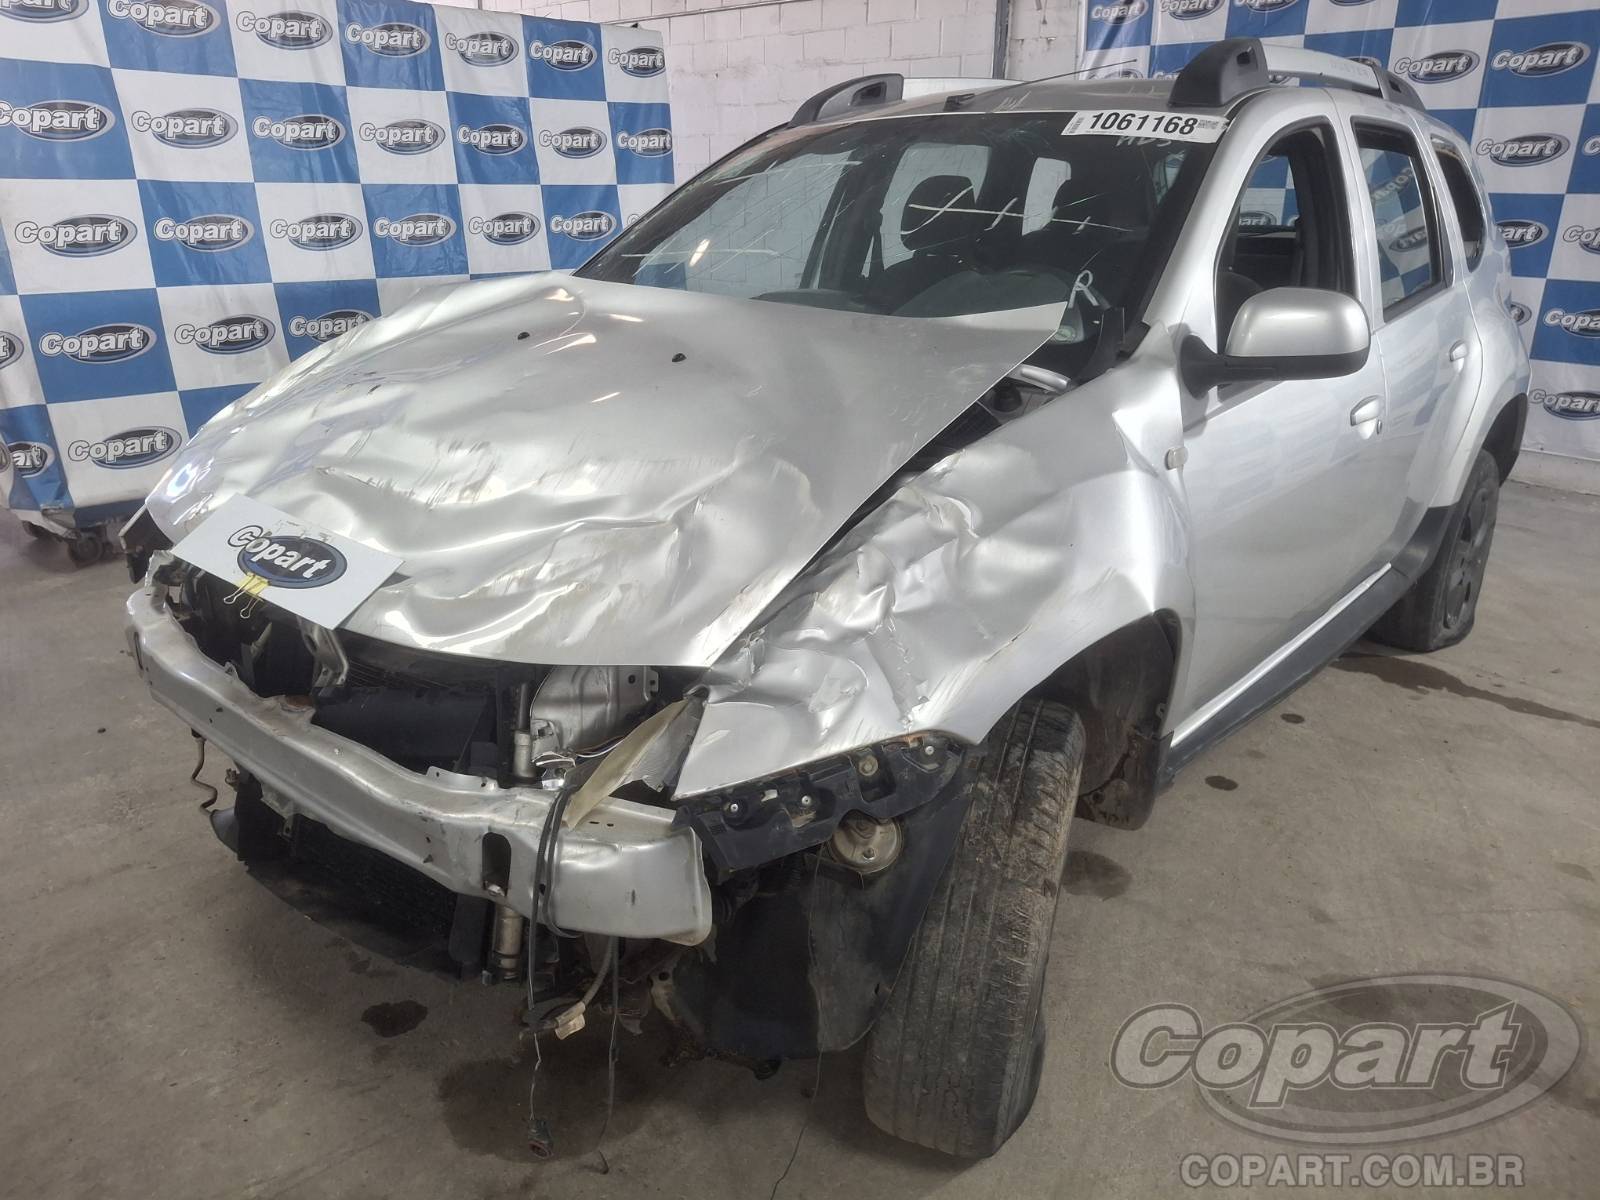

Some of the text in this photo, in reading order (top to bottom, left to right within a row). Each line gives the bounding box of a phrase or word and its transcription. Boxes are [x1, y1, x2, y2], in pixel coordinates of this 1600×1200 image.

[108, 0, 208, 27] Copart
[1092, 4, 1139, 19] Copart
[237, 12, 321, 38] Copart
[346, 23, 422, 50] Copart
[446, 32, 509, 56] Copart
[530, 41, 588, 63] Copart
[608, 49, 663, 67] Copart
[1395, 56, 1467, 79] Copart
[1492, 46, 1580, 70] Copart
[132, 111, 223, 138] Copart
[253, 116, 335, 140] Copart
[360, 123, 434, 144] Copart
[1090, 112, 1198, 134] 1061168
[457, 127, 518, 147] Copart
[539, 131, 597, 149] Copart
[618, 132, 671, 151] Copart
[1476, 139, 1556, 159] Copart
[15, 220, 120, 247] Copart
[155, 217, 240, 242] Copart
[270, 219, 349, 241] Copart
[375, 217, 449, 240] Copart
[469, 217, 528, 238] Copart
[551, 215, 608, 236] Copart
[1501, 226, 1539, 241] art
[1544, 309, 1600, 332] Copa
[41, 329, 143, 358] Copart
[175, 320, 265, 346] Copart
[69, 430, 167, 461] Copart
[228, 525, 331, 578] Copart
